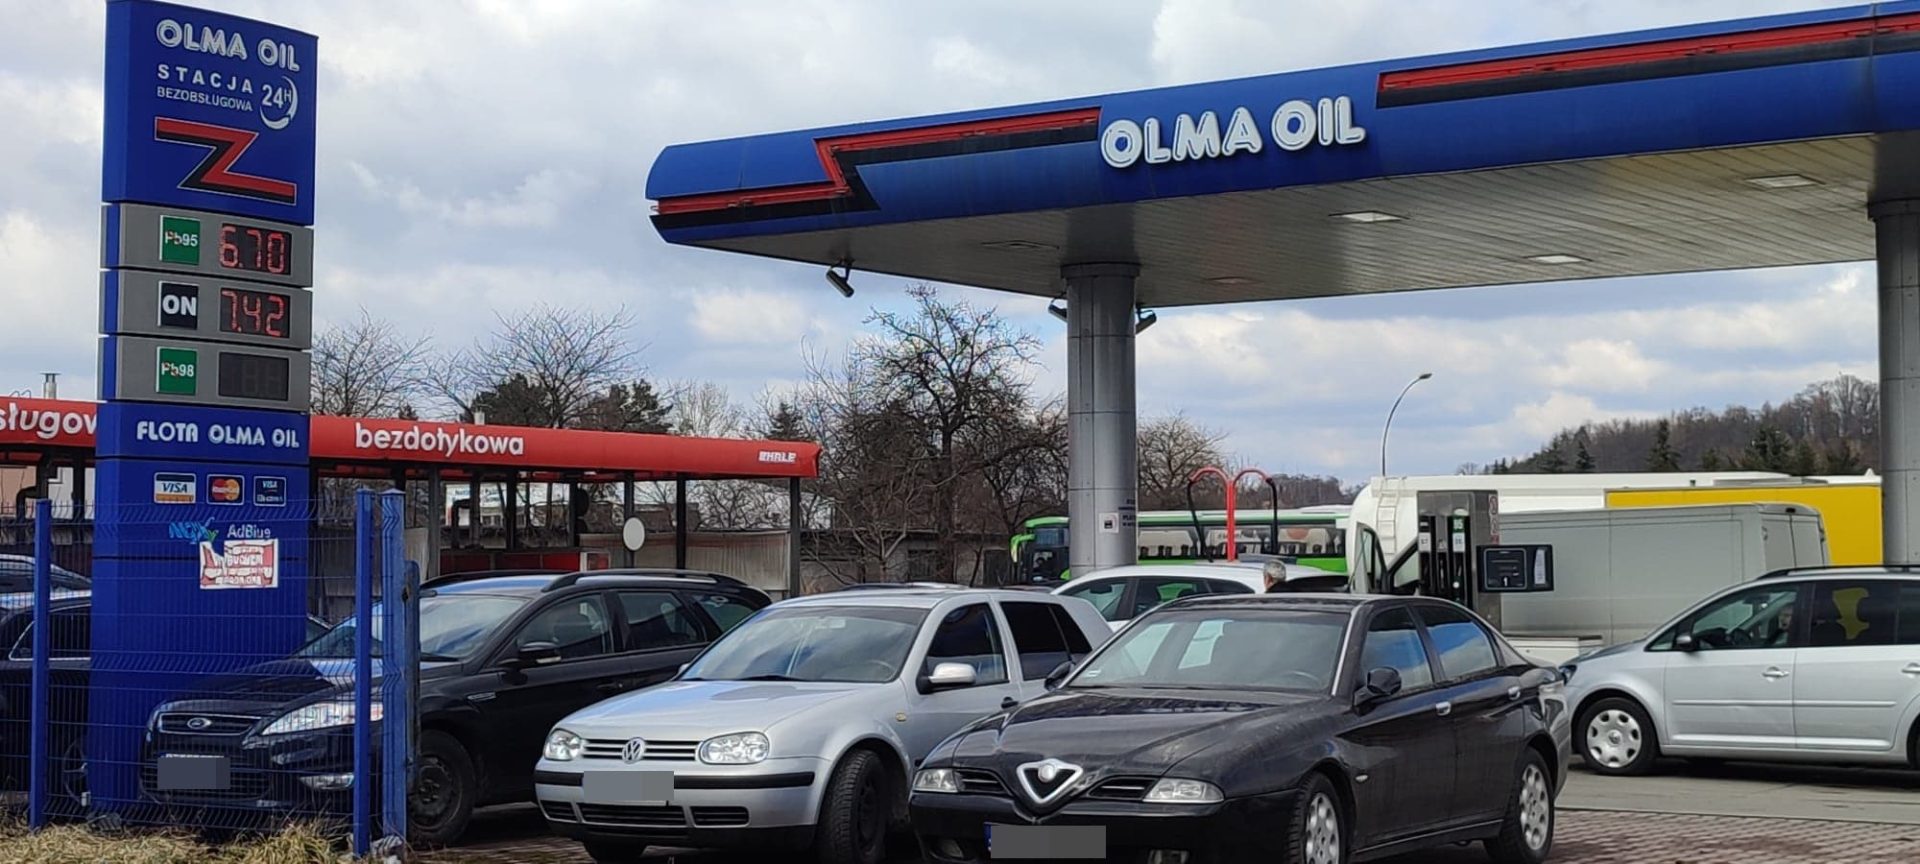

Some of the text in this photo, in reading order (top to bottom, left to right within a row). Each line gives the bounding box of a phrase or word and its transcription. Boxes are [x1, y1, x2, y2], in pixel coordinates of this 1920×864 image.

[156, 19, 300, 72] OLMA OIL
[157, 63, 253, 94] STACJA
[157, 86, 253, 112] BEZOBSŁUGOWA
[1100, 96, 1366, 168] OLMA OIL
[164, 230, 198, 247] Pb95
[219, 225, 285, 273] 6.70
[162, 295, 197, 316] ON
[221, 290, 285, 337] 7.42
[161, 362, 194, 377] Pb98
[137, 421, 300, 448] FLOTA OLMA OIL
[355, 422, 524, 457] bezdotykowa
[161, 482, 188, 493] VISA
[226, 523, 271, 539] AdBlue
